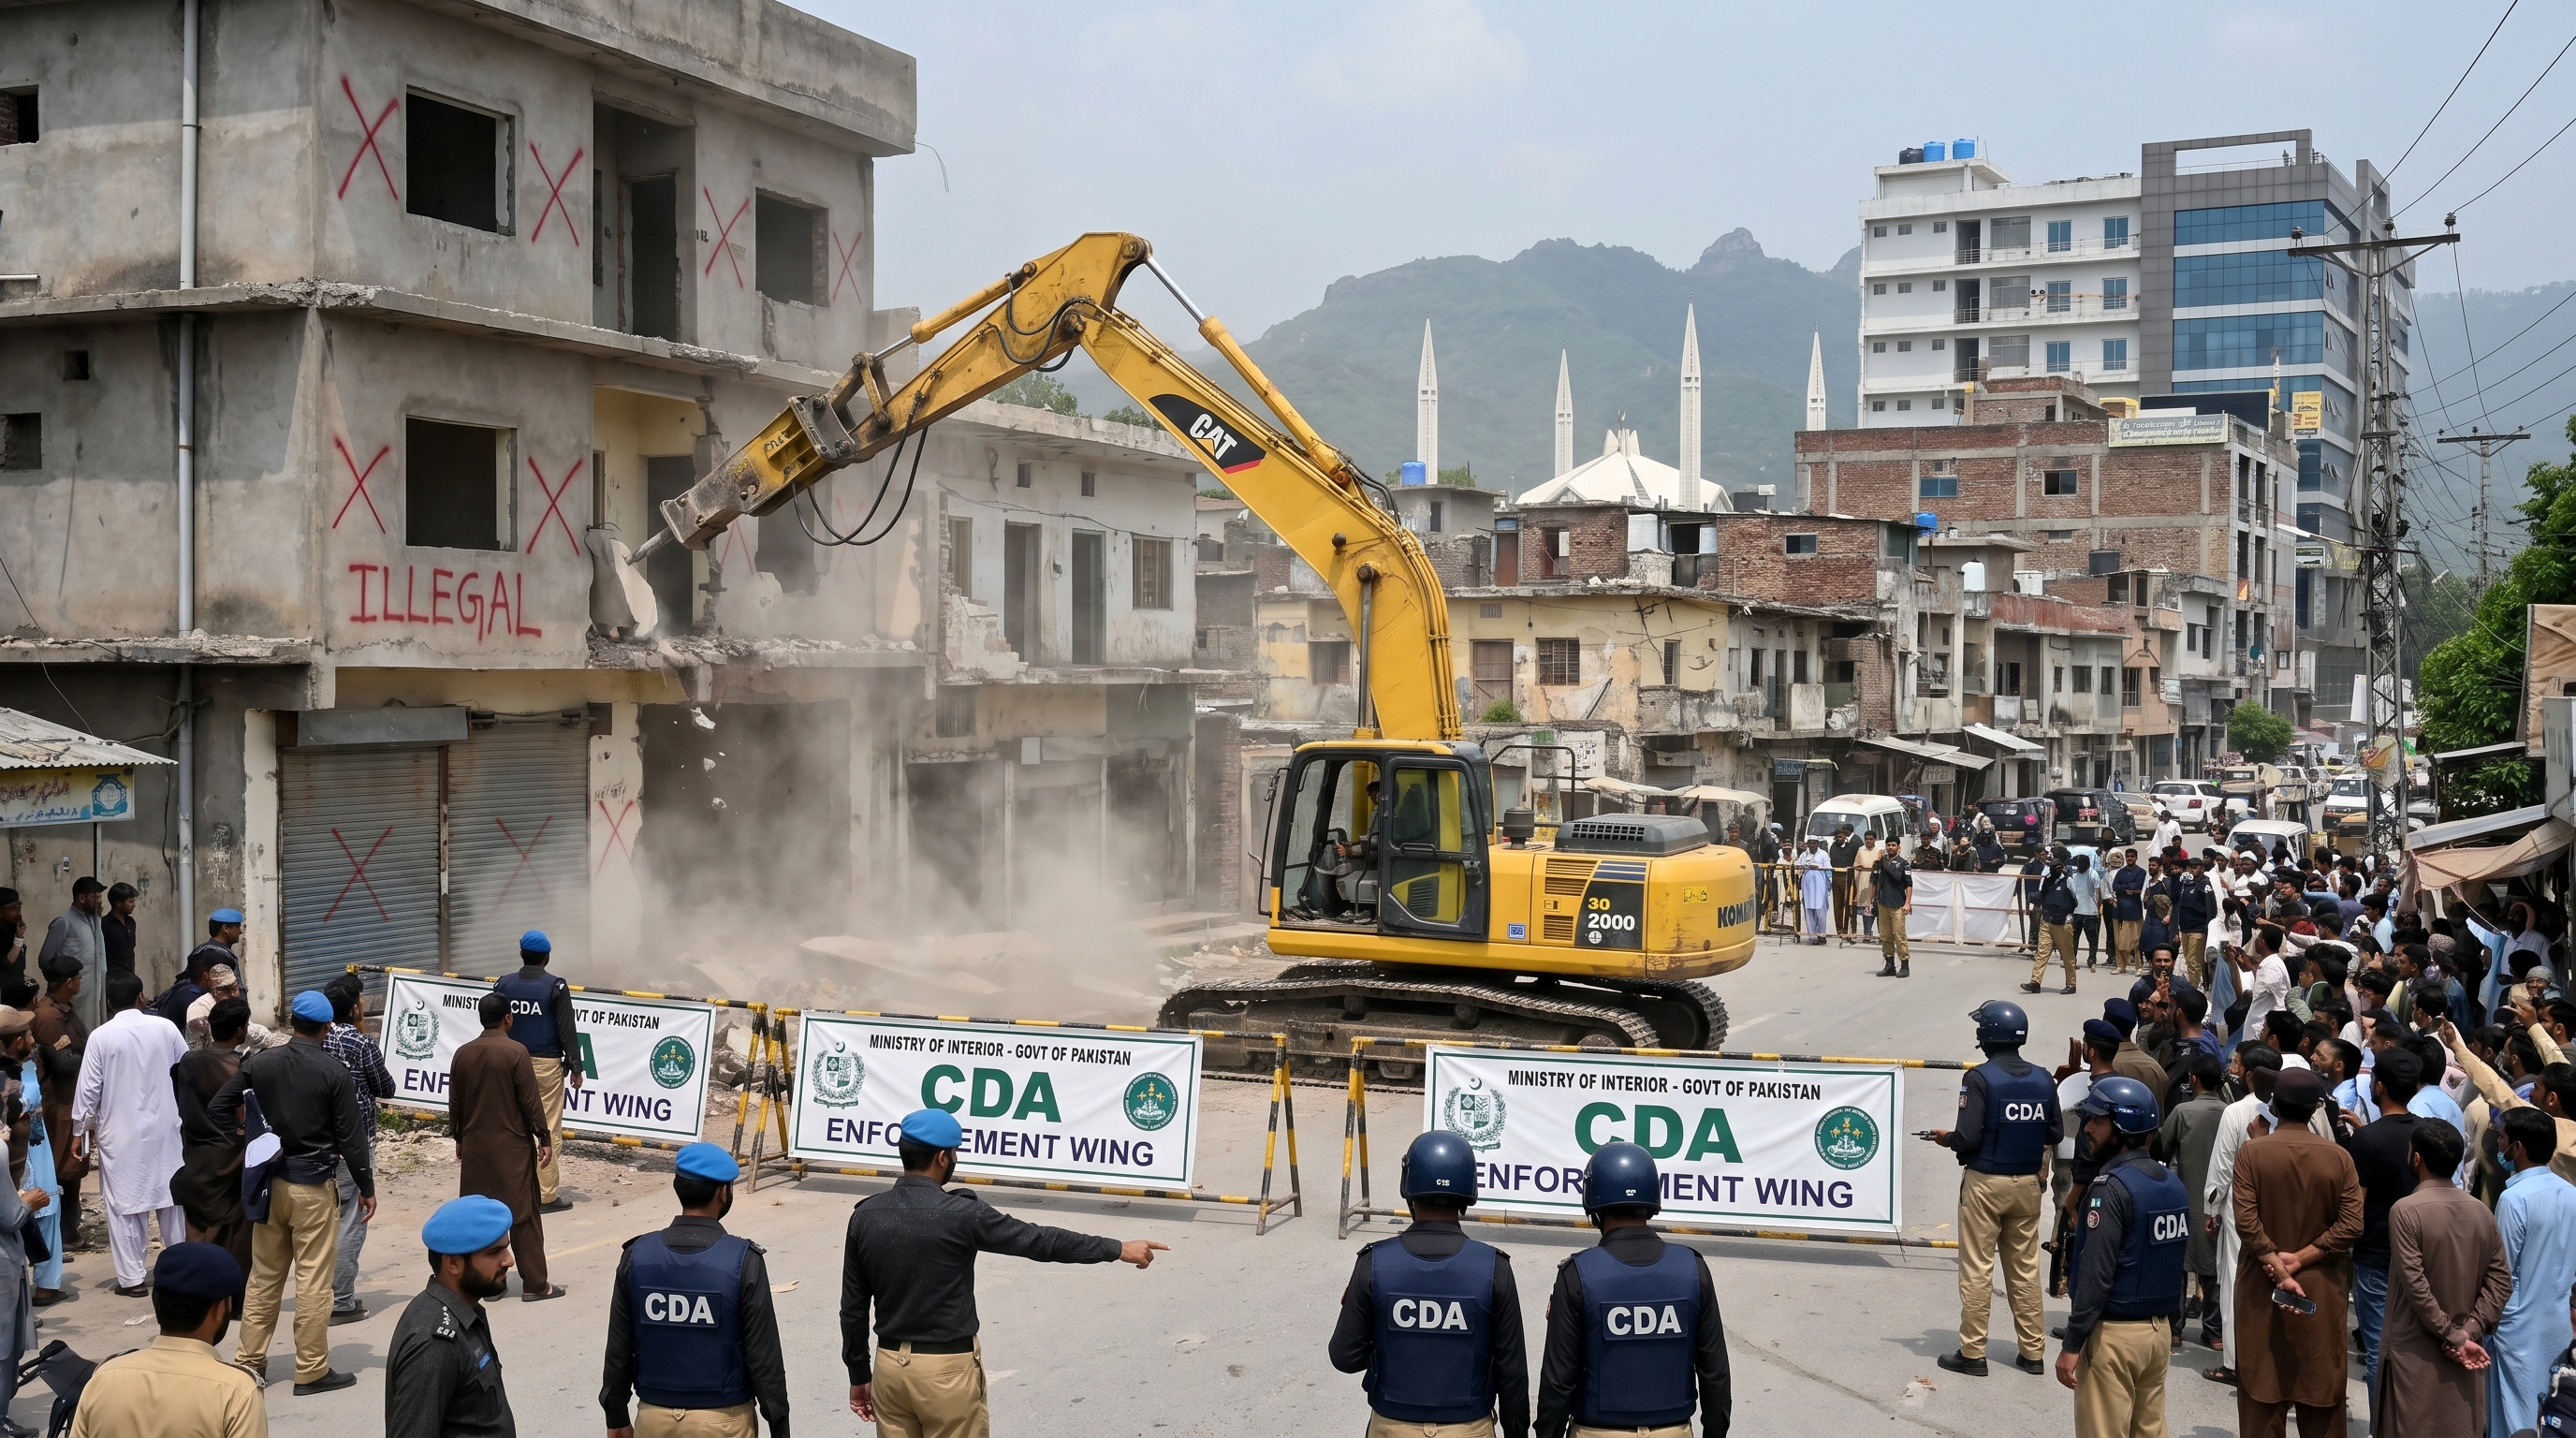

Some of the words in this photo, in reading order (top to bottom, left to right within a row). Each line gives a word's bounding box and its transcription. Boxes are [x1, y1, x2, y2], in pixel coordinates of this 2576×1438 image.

[1189, 413, 1237, 461] CAT
[348, 563, 543, 643] ILLEGAL
[1588, 897, 1611, 911] 30
[1588, 913, 1636, 932] 2000
[442, 993, 480, 1011] MINIST
[591, 1010, 606, 1024] OF
[607, 1011, 660, 1030] PAKISTAN
[510, 999, 543, 1016] CDA
[870, 1034, 927, 1051] MINISTRY
[929, 1037, 945, 1053] OF
[947, 1039, 1004, 1057] INTERIOR
[1015, 1044, 1048, 1061] GOVT
[1051, 1046, 1068, 1062] OF
[1070, 1047, 1132, 1066] PAKISTAN
[920, 1064, 1061, 1123] CDA
[1508, 1069, 1575, 1089] MINISTRY
[1579, 1073, 1597, 1090] OF
[1602, 1074, 1668, 1093] INTERIOR
[1682, 1078, 1721, 1096] GOVT
[1725, 1080, 1745, 1097] OF
[1749, 1081, 1821, 1101] PAKISTAN
[603, 1092, 672, 1122] WING
[2005, 1103, 2045, 1121] CDA
[827, 1117, 1061, 1161] ENFOEMENT
[1069, 1136, 1154, 1167] WING
[1574, 1101, 1743, 1164] CDA
[1476, 1162, 1744, 1203] NFORENT
[1754, 1177, 1853, 1209] WING
[2154, 1212, 2189, 1241] CDA
[644, 1292, 715, 1325] CDA
[1392, 1299, 1469, 1330] CDA
[1606, 1304, 1682, 1336] CDA
